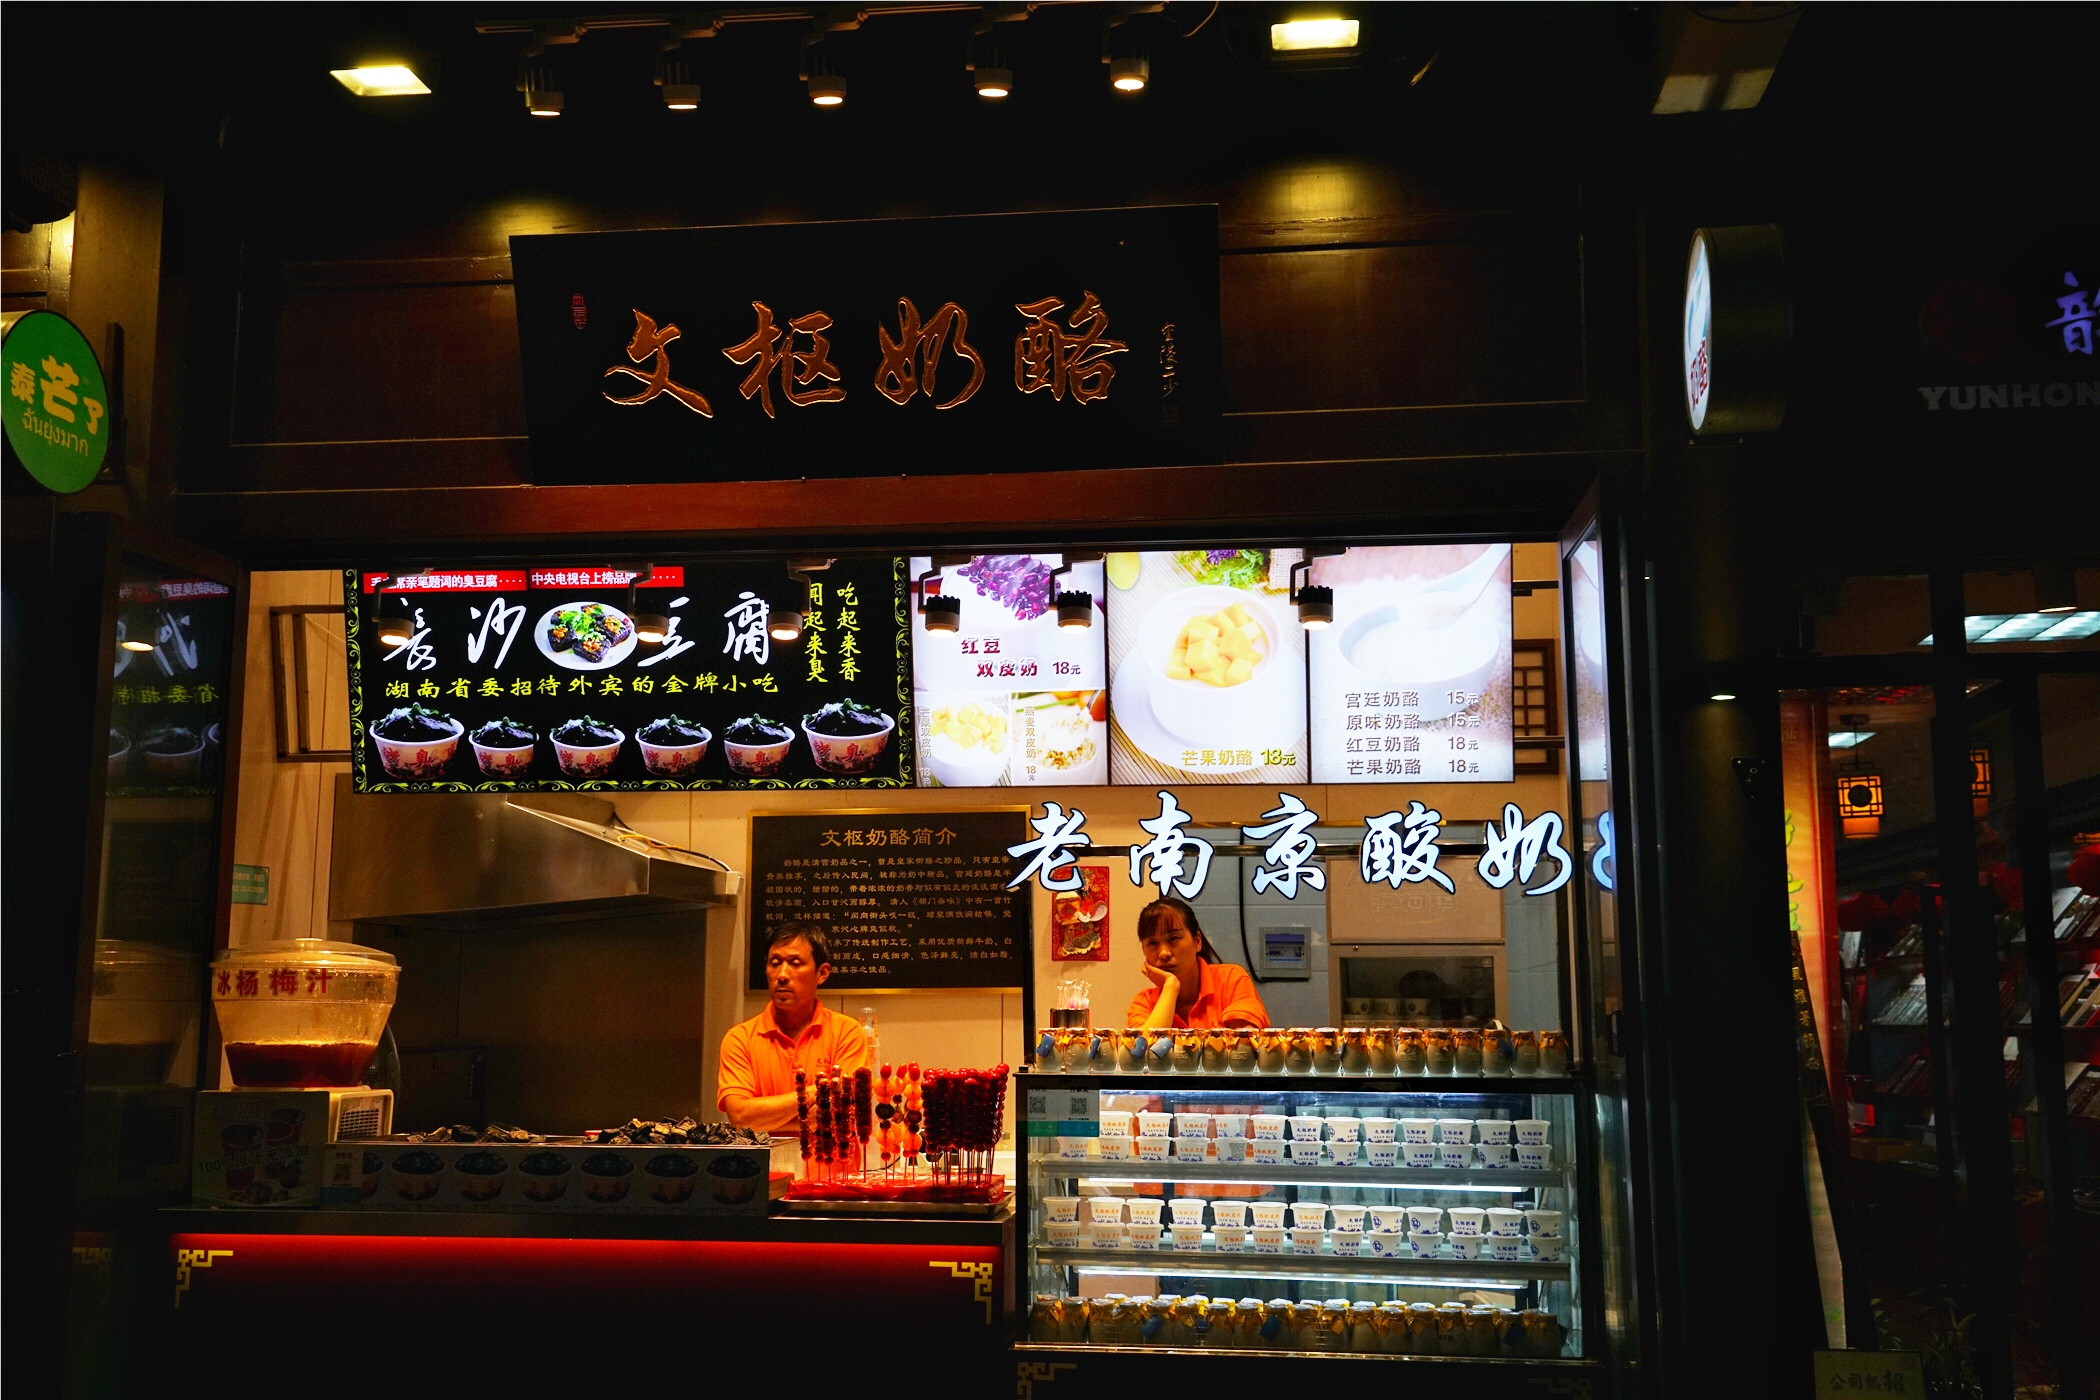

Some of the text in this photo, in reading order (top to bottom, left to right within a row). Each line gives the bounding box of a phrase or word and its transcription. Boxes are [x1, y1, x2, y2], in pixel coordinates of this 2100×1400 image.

[602, 289, 1130, 420] 文枢奶酪
[10, 354, 104, 435] 泰芒了
[21, 406, 90, 457] ฉันยุ่งมาก
[836, 581, 861, 682] 吃起来香
[960, 634, 1002, 656] 红豆
[975, 658, 1082, 678] 双皮奶 18元
[384, 673, 780, 699] 湖南省委招待外宾的金牌小吃
[1344, 690, 1480, 709] 宫廷奶酪 15元
[1023, 705, 1038, 759] 燕麦双皮奶
[1344, 712, 1421, 731] 原味奶酪
[1344, 735, 1480, 753] 红豆奶酪 18元
[1181, 747, 1297, 767] 芒果奶酪 18元
[1345, 757, 1481, 776] 芒果奶酪 18元
[819, 826, 958, 848] 文枢奶酪简介
[1006, 790, 1573, 898] 老南京酸奶
